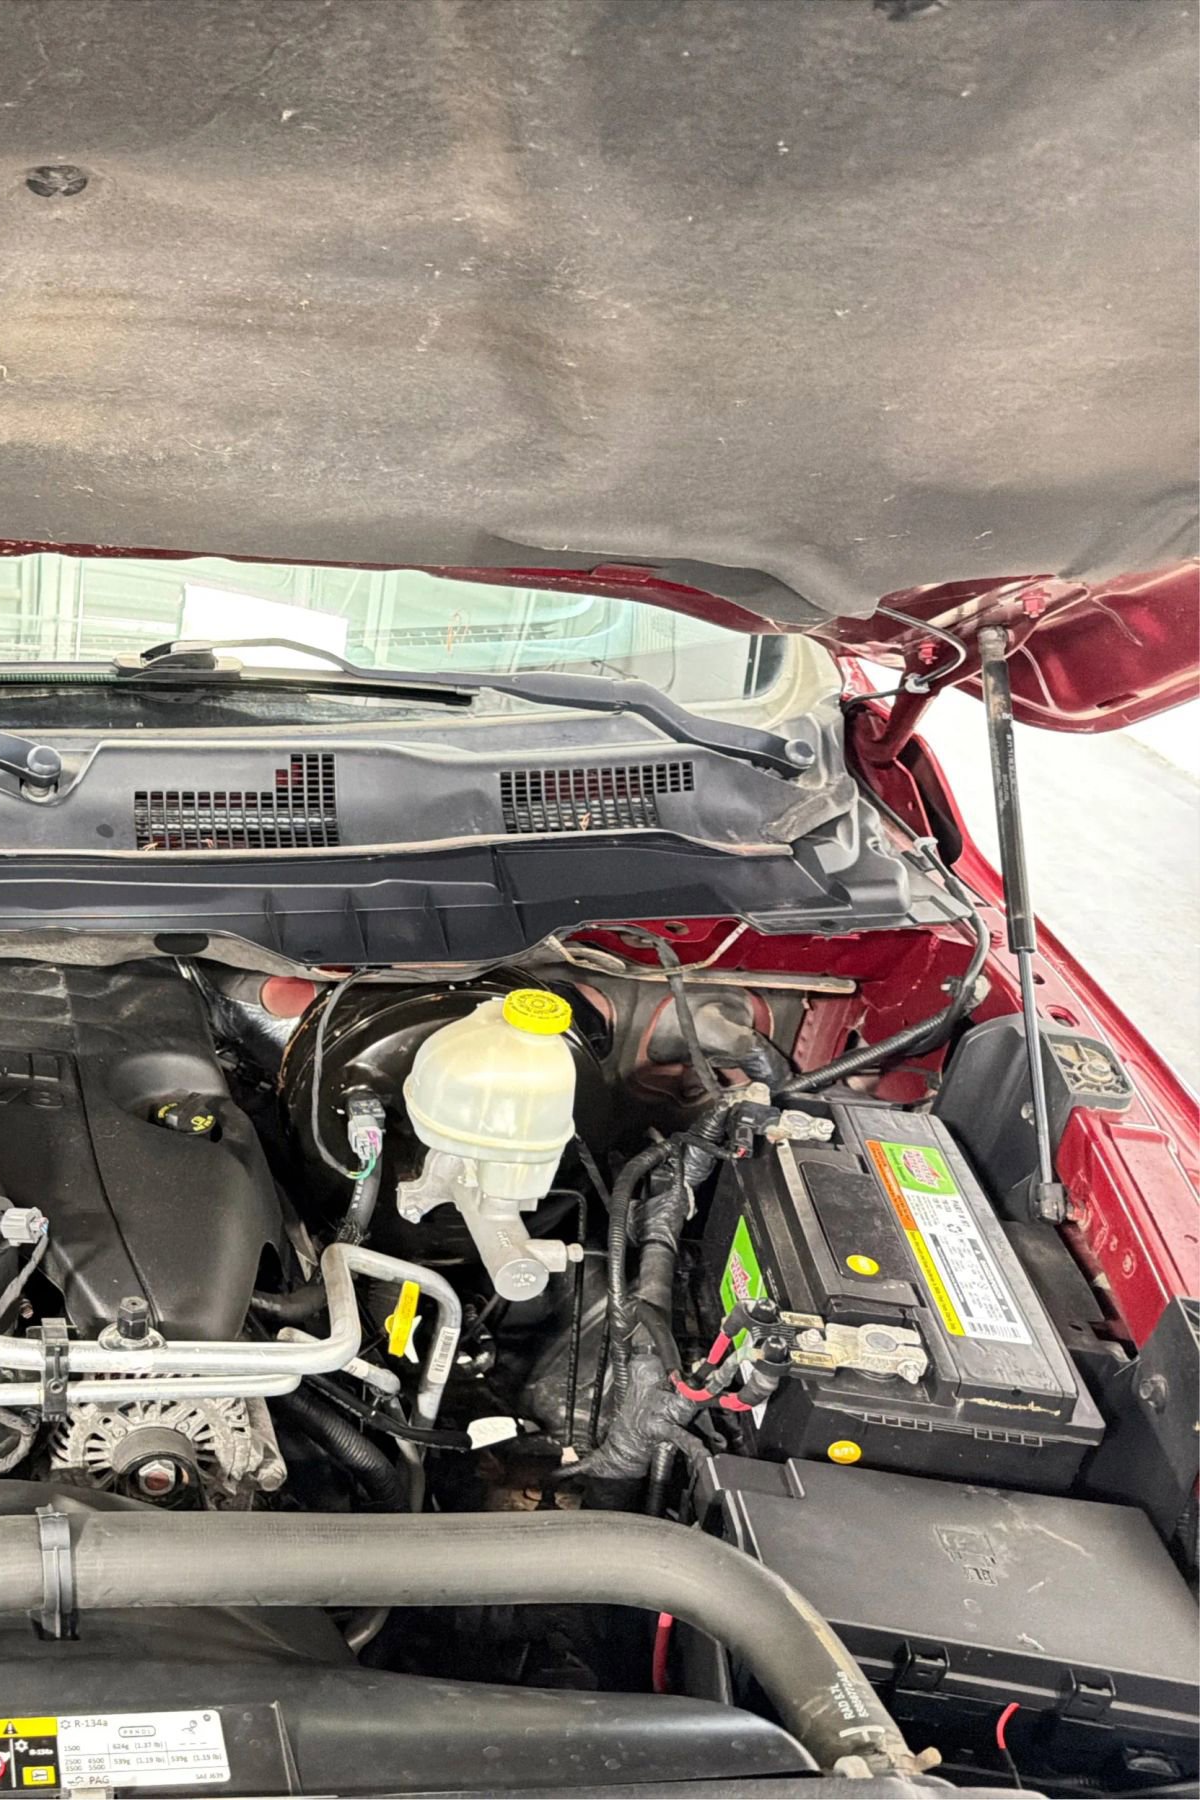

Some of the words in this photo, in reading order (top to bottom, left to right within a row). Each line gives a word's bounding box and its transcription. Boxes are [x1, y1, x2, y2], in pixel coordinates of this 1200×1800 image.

[839, 1701, 855, 1720] RAD
[74, 1719, 109, 1728] R-134a
[88, 1775, 110, 1785] PAG
